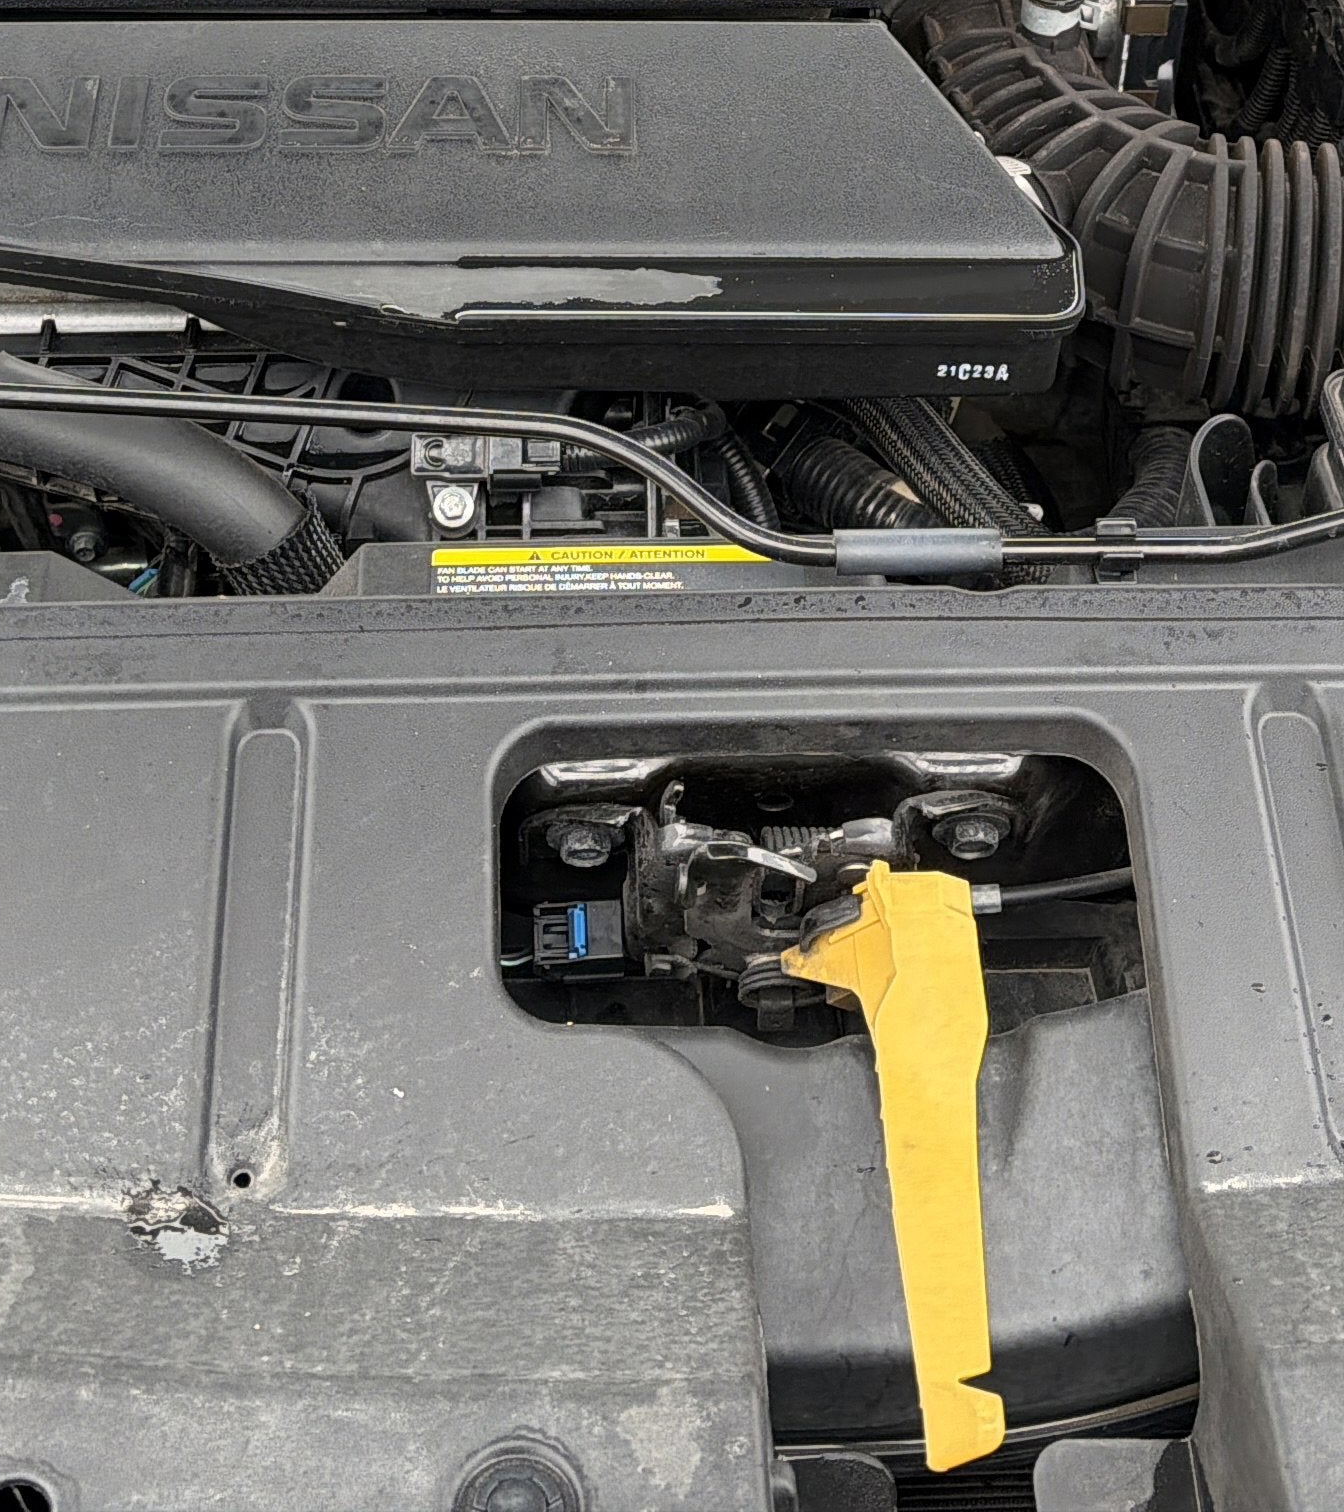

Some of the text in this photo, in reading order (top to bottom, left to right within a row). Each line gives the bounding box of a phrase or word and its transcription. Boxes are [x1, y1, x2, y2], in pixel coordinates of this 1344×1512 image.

[551, 550, 613, 561] CAUTION
[629, 549, 706, 560] ATTENTION
[437, 566, 455, 575] FAN
[456, 566, 486, 575] BLADE
[487, 566, 508, 574] CAN
[508, 565, 536, 574] START
[538, 565, 549, 573] AT
[550, 564, 569, 573] ANY
[437, 575, 450, 584] TO
[451, 575, 476, 583] HELP
[476, 574, 504, 583] AVOID
[504, 573, 554, 582] PERSONAL
[436, 585, 449, 594] LE
[449, 584, 508, 594] VENTILATEUR
[508, 583, 543, 592] RISQUE
[544, 583, 556, 591] DE
[617, 581, 642, 590] TOUT
